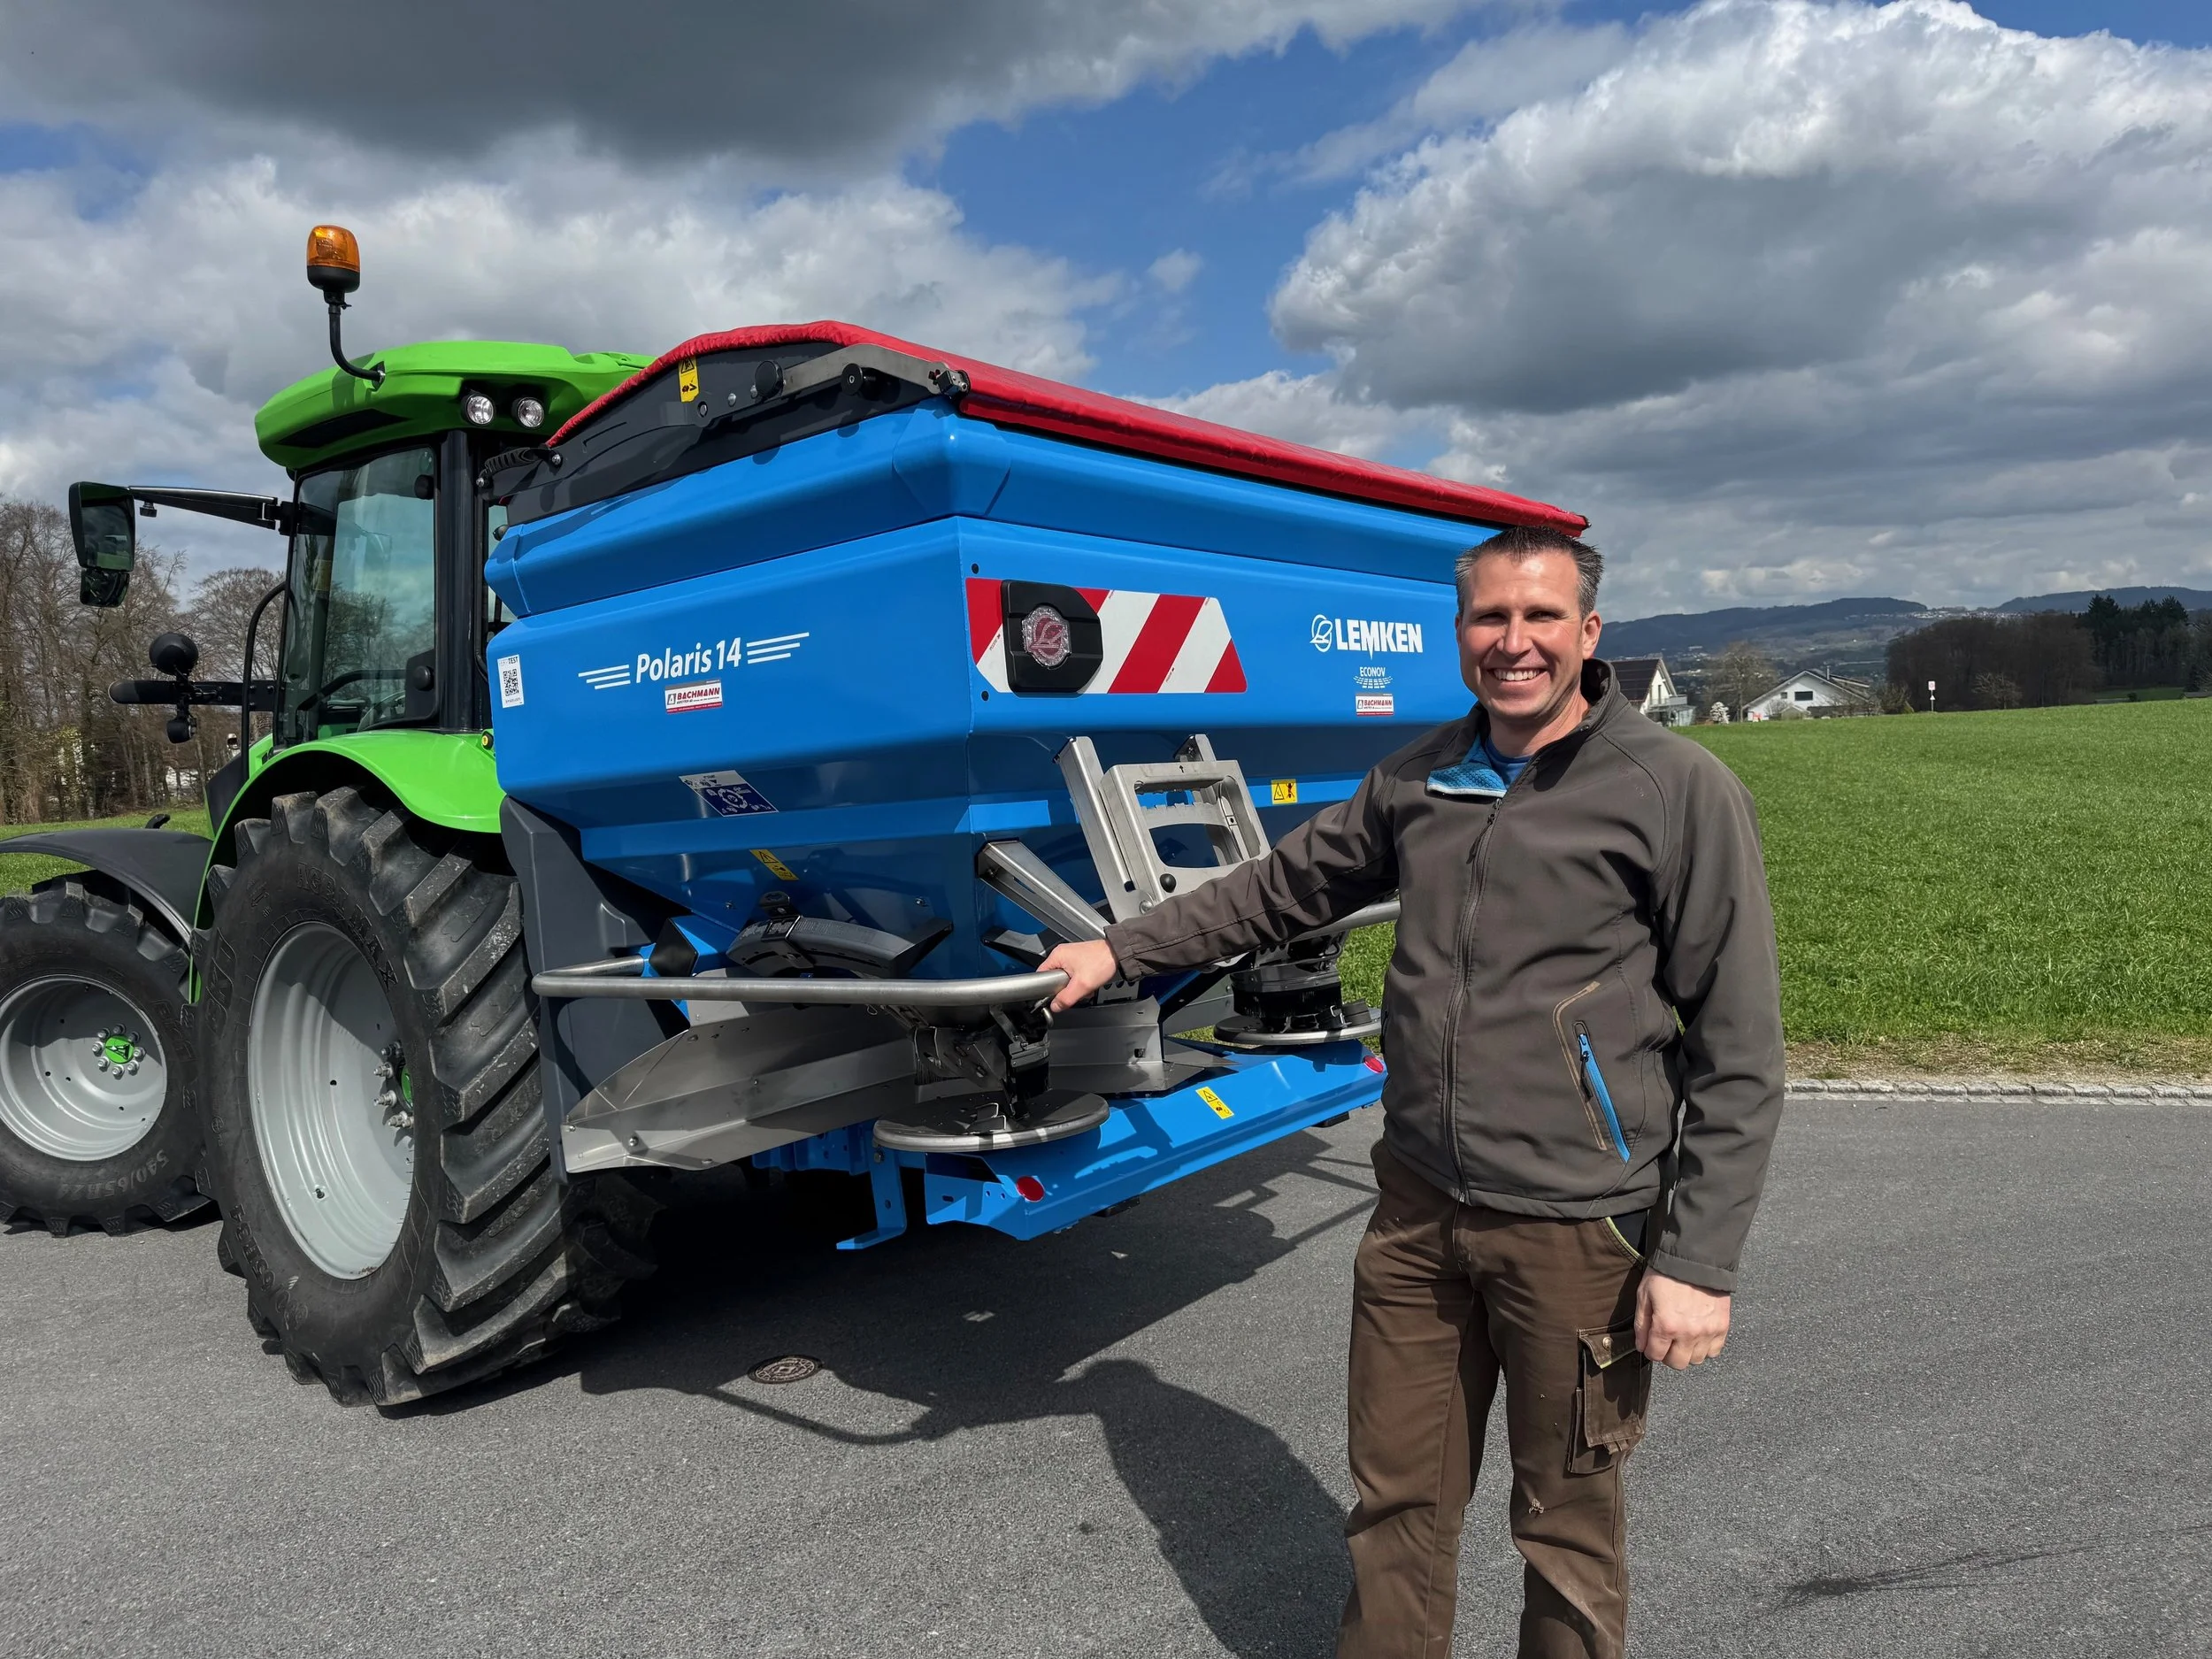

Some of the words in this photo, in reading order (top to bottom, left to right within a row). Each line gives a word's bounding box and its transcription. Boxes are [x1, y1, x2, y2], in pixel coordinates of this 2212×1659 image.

[636, 643, 711, 683] Polaris
[716, 637, 742, 670] 14
[1334, 618, 1424, 660] LEMKEN
[1359, 666, 1386, 677] ECONOV
[677, 687, 720, 700] BACHMANN
[55, 1148, 170, 1202] 540/65R24
